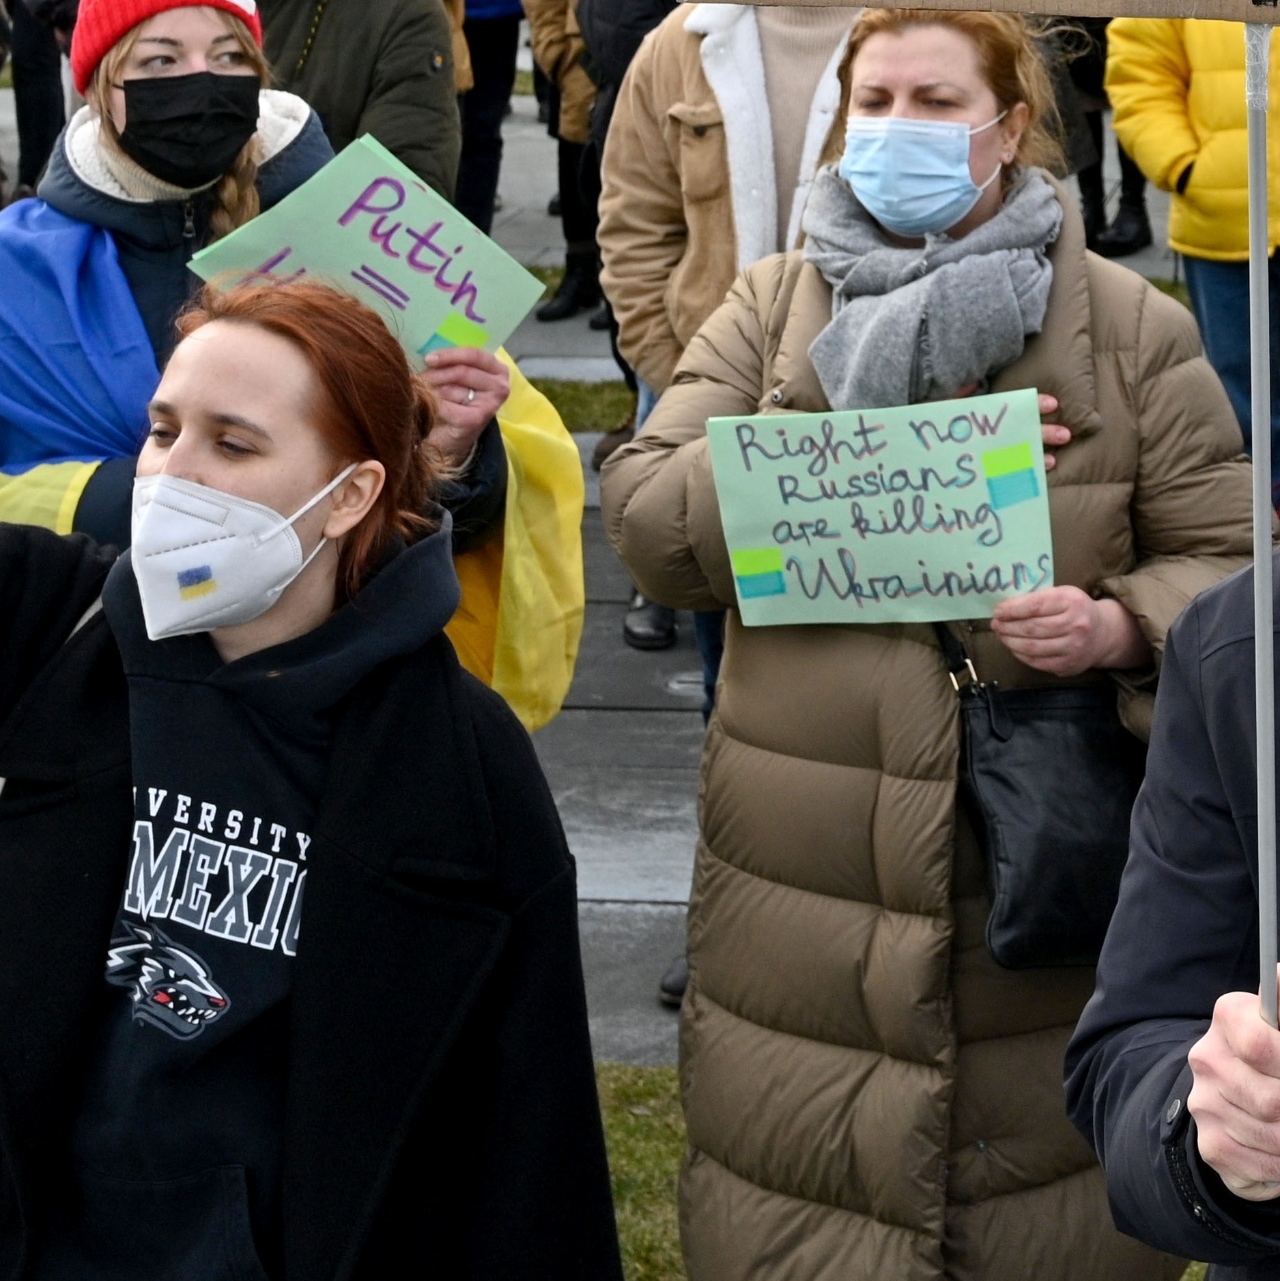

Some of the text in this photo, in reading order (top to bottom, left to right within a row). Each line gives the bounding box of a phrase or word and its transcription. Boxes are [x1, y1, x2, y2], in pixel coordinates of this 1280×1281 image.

[337, 176, 486, 324] Putin
[736, 403, 1008, 477] Right now
[778, 453, 977, 506] Russians
[773, 494, 1003, 547] are killing
[786, 547, 1051, 608] Ukrainians
